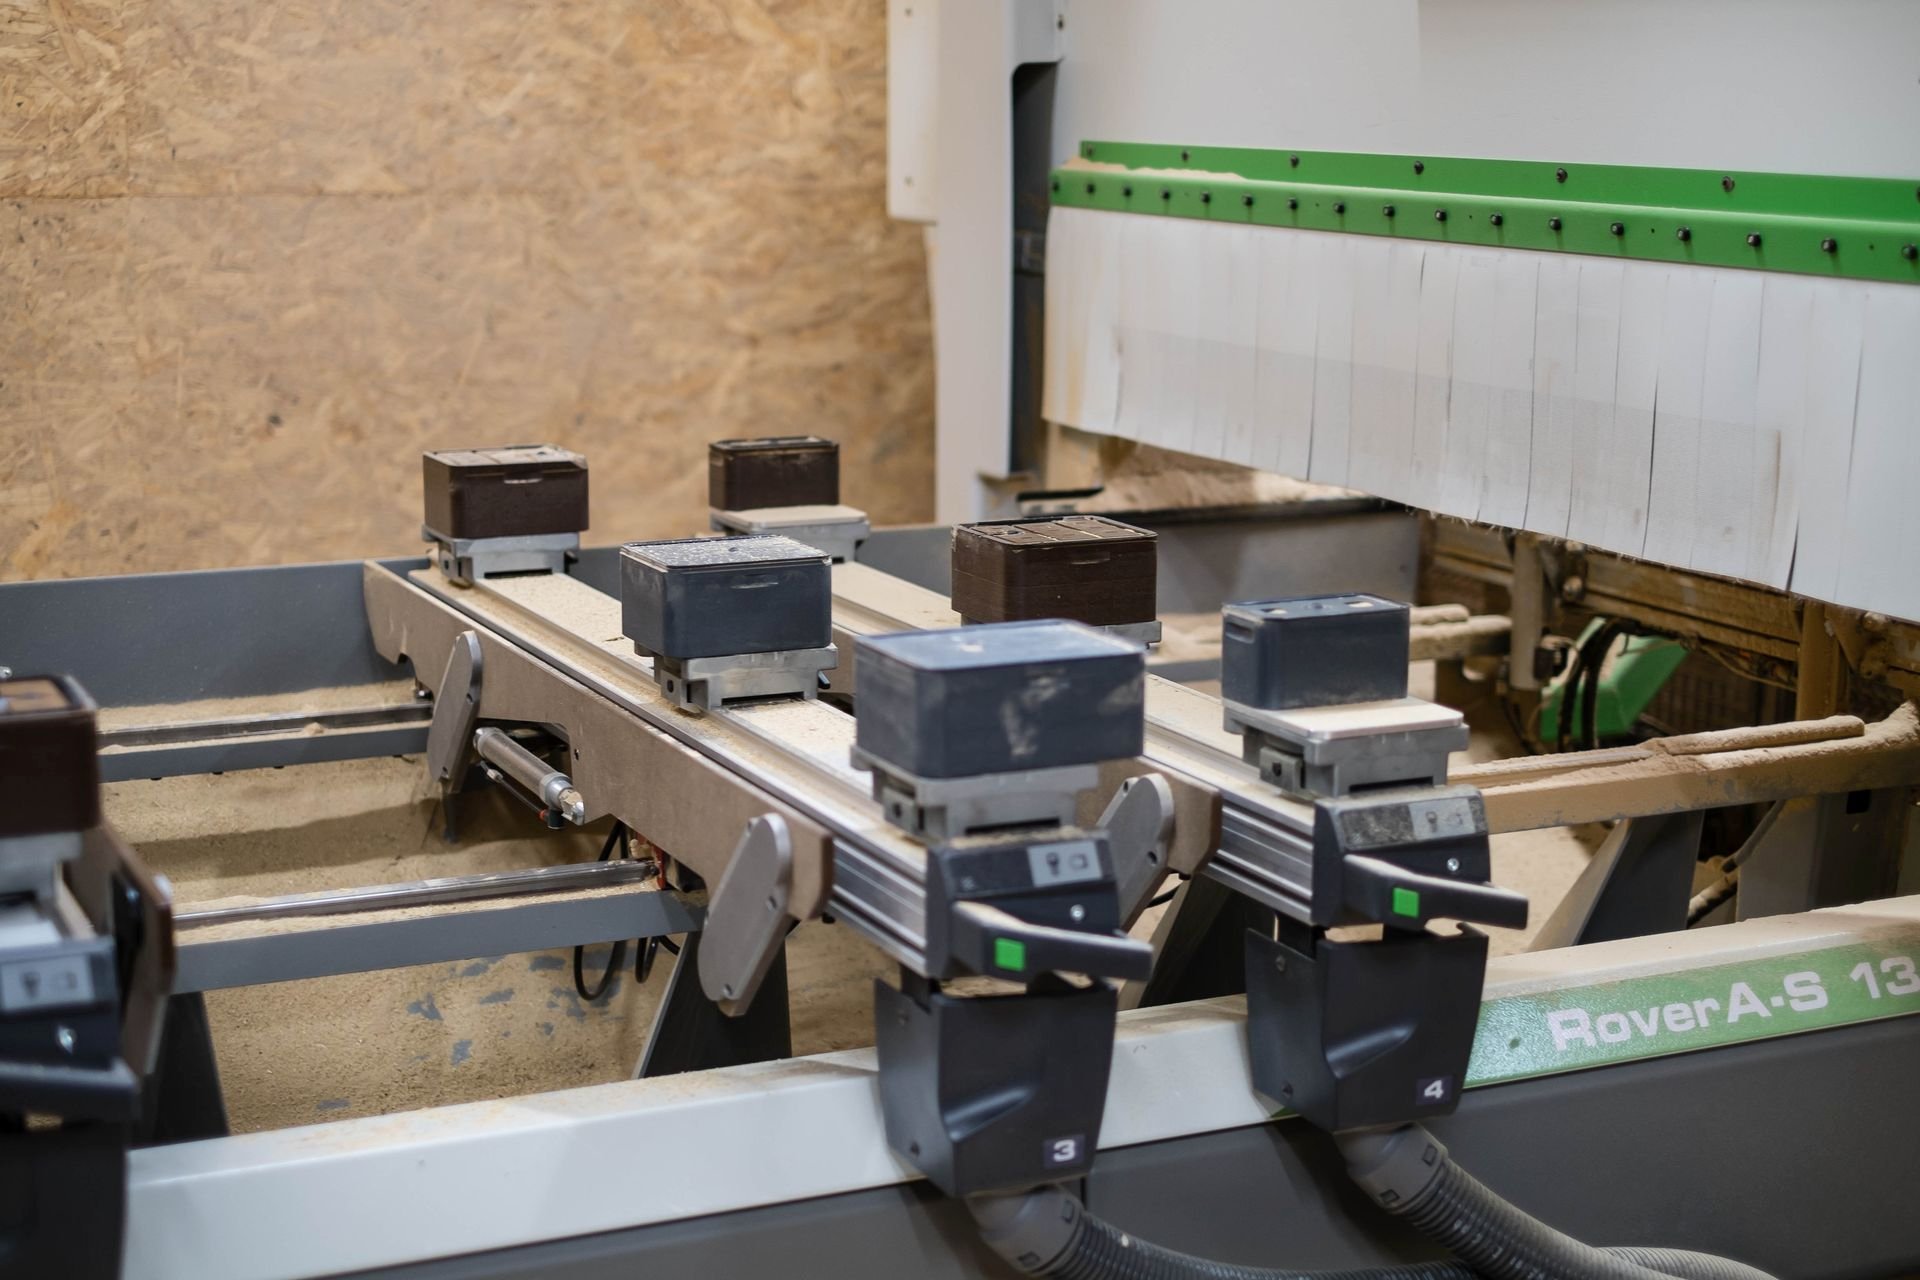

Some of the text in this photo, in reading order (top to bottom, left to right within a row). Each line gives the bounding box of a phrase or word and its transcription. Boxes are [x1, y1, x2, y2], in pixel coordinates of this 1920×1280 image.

[1849, 956, 1920, 998] 13
[1424, 1079, 1444, 1099] 4
[1053, 1139, 1075, 1162] 3
